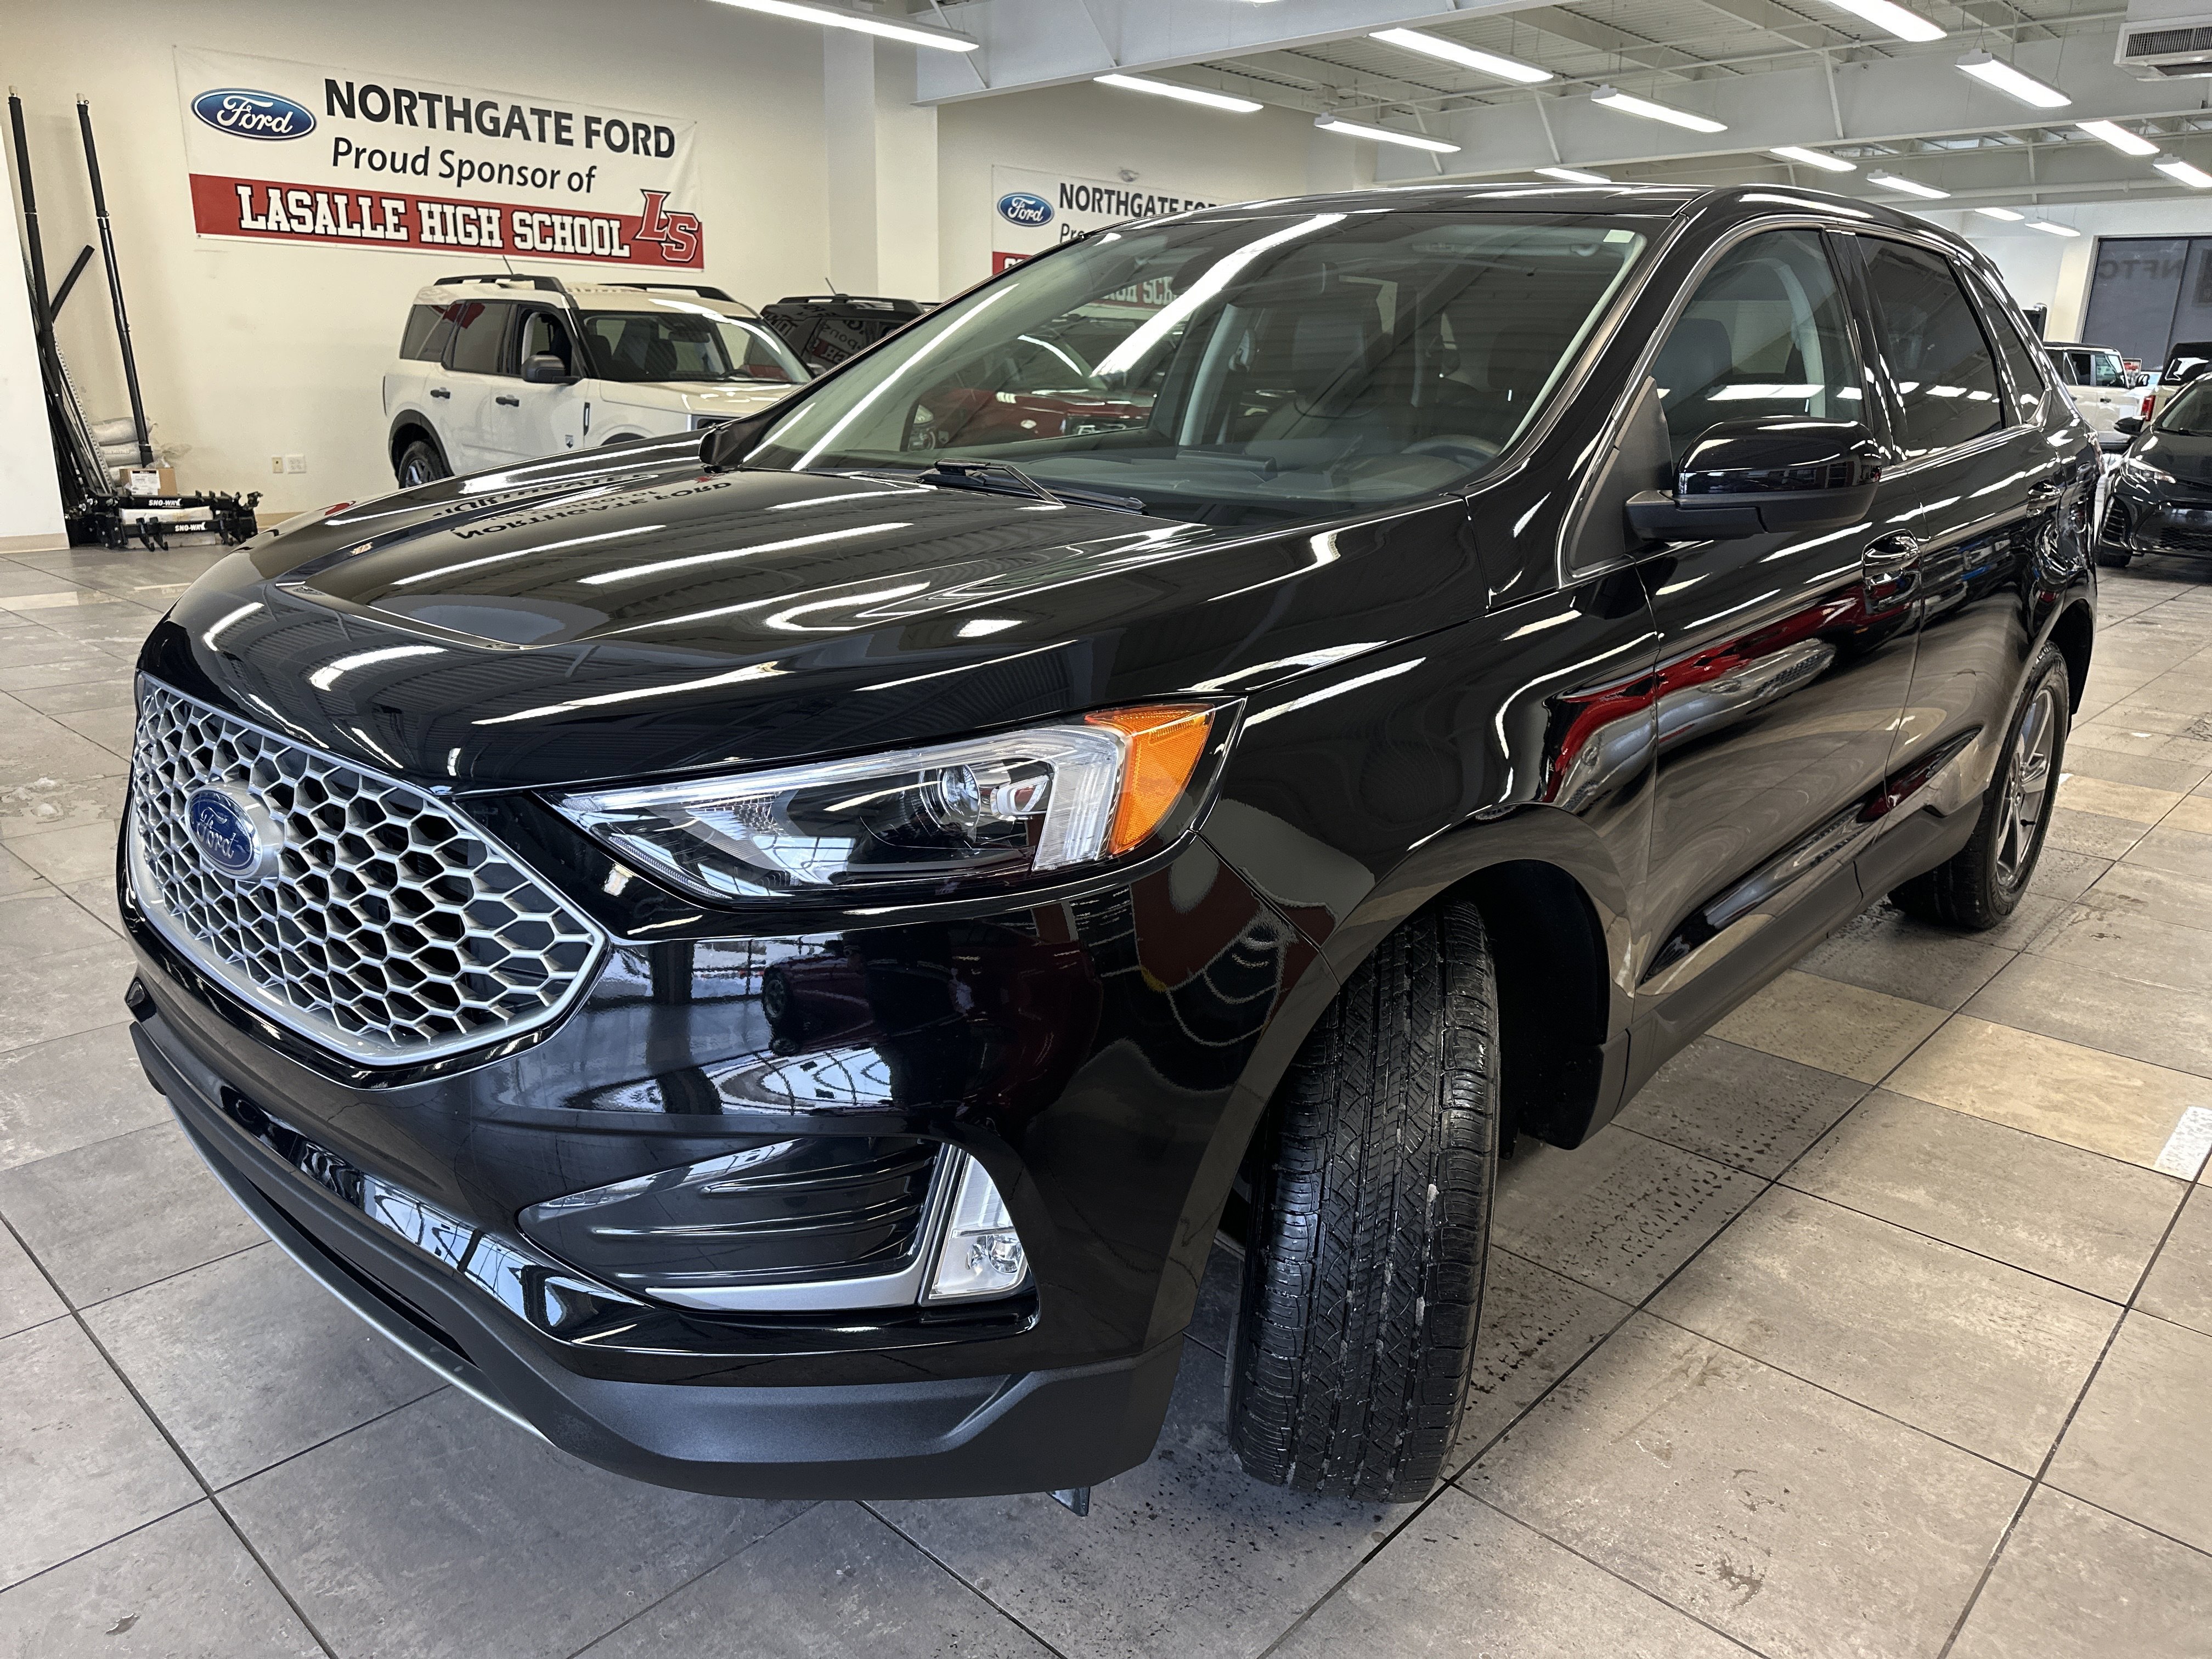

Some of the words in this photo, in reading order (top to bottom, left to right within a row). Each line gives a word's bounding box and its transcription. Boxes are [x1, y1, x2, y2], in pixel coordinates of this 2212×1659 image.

[217, 95, 293, 133] Ford
[325, 78, 573, 146] NORTHGATE
[584, 115, 675, 158] FORD
[332, 137, 430, 176] Proud
[438, 149, 561, 189] Sponsor
[567, 166, 597, 193] of
[1007, 197, 1045, 222] Ford
[1059, 183, 1179, 217] NORTHGATE
[236, 184, 409, 241] LASALLE
[416, 201, 504, 248] HIGH
[511, 210, 631, 258] SCHOOL
[632, 189, 699, 263] LS
[148, 498, 182, 506] SNO-WAY
[175, 522, 206, 532] SNO-WAY
[196, 806, 236, 859] Ford
